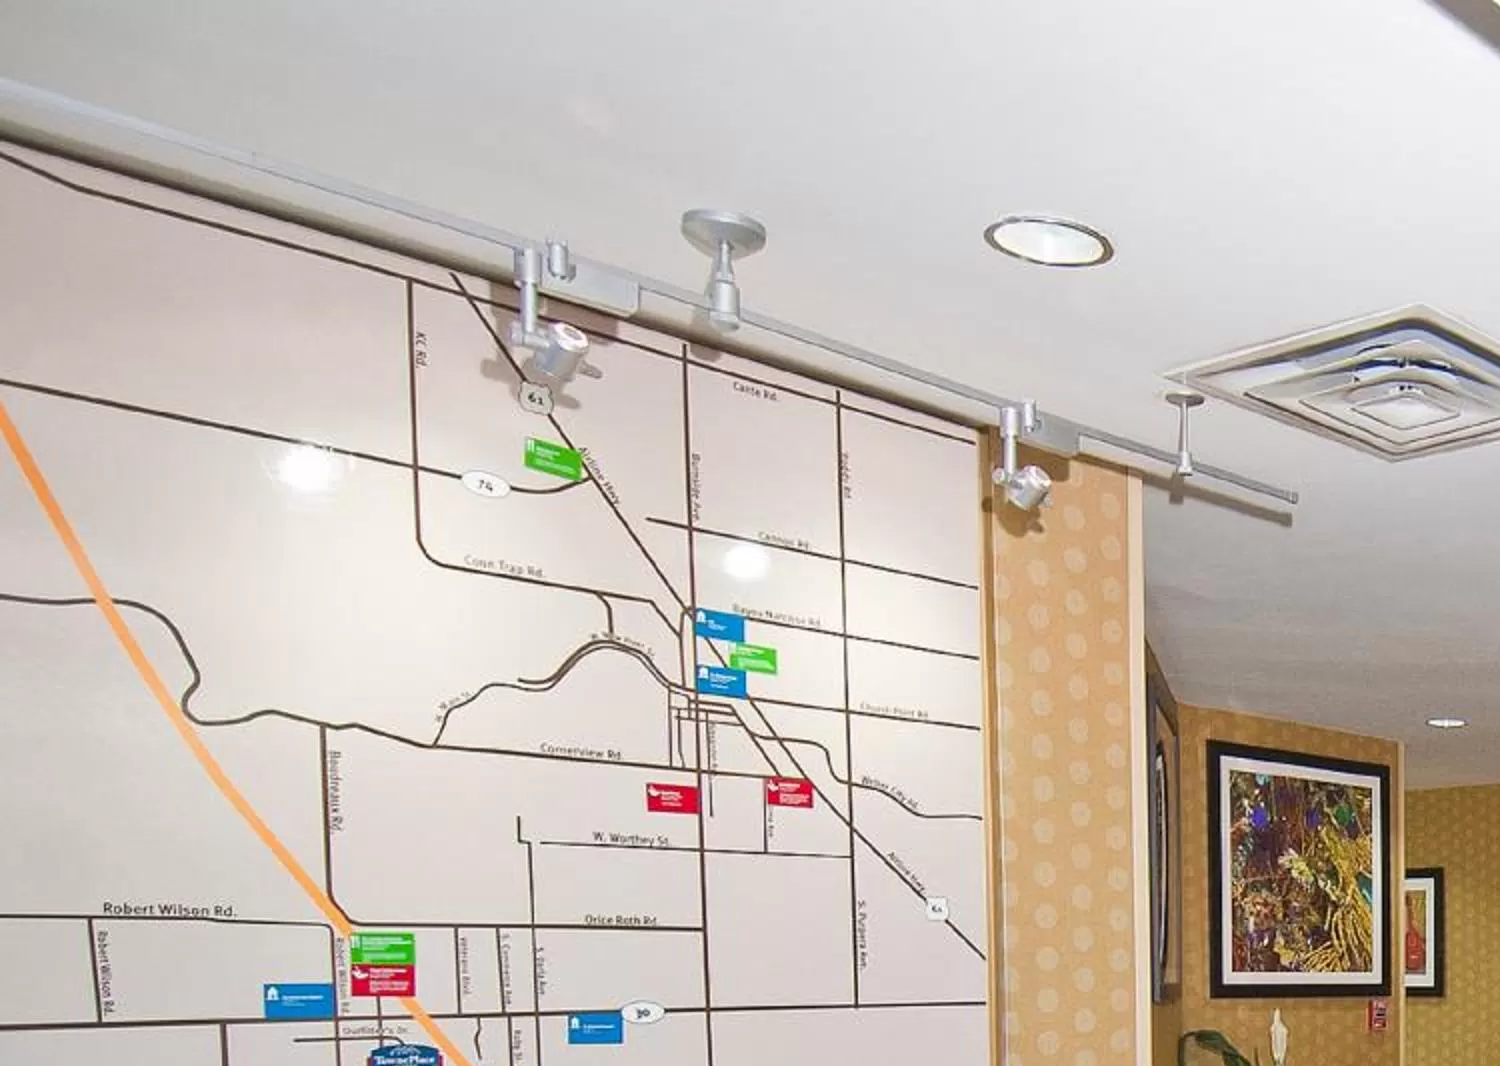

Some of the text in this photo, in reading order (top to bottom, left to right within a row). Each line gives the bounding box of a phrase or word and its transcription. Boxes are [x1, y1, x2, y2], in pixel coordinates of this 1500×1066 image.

[102, 902, 239, 918] Robert Wilson Rd.
[97, 930, 110, 963] Robert
[101, 964, 113, 998] Wilson
